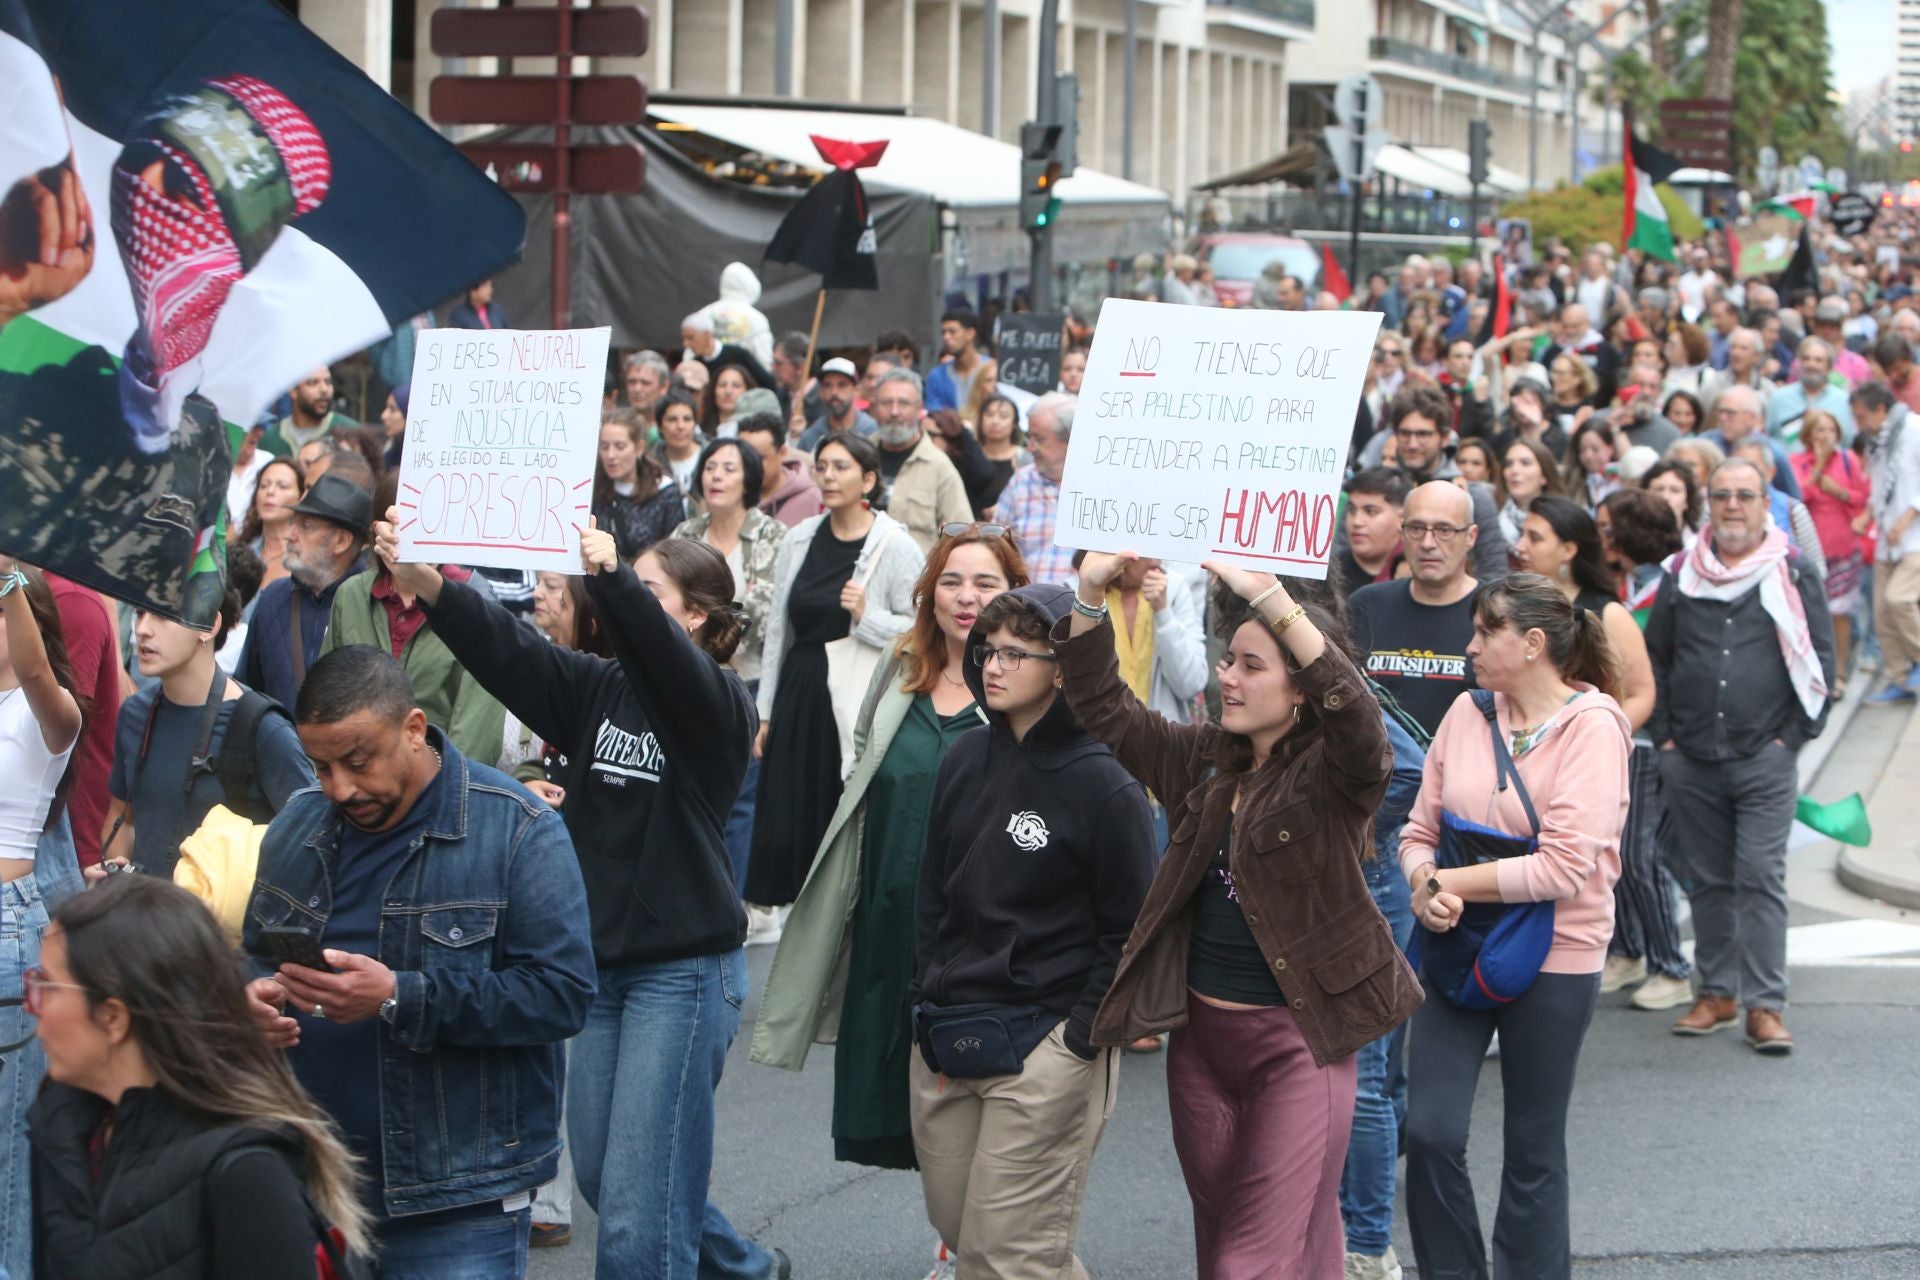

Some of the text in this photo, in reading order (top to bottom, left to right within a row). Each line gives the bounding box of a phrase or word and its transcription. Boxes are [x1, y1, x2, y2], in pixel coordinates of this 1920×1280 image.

[426, 334, 586, 372] SI ERES NEUTRAL
[1124, 336, 1341, 380] NO TIENES QUE
[1000, 357, 1050, 386] GAZA
[431, 379, 583, 406] EN SITUACIONES
[1095, 391, 1315, 424] SER PALESTINO PARA
[411, 408, 568, 446] DE INJUSTICIA
[413, 451, 558, 470] HAS ELEGIDO EL LADO
[1093, 435, 1336, 473] DEFENDER A PALESTINA
[420, 472, 567, 546] OPRESOR
[1069, 487, 1336, 558] TIENES QUE SER HUMANO
[1367, 655, 1466, 675] QUIKSILVER
[603, 773, 627, 787] SEMPRE
